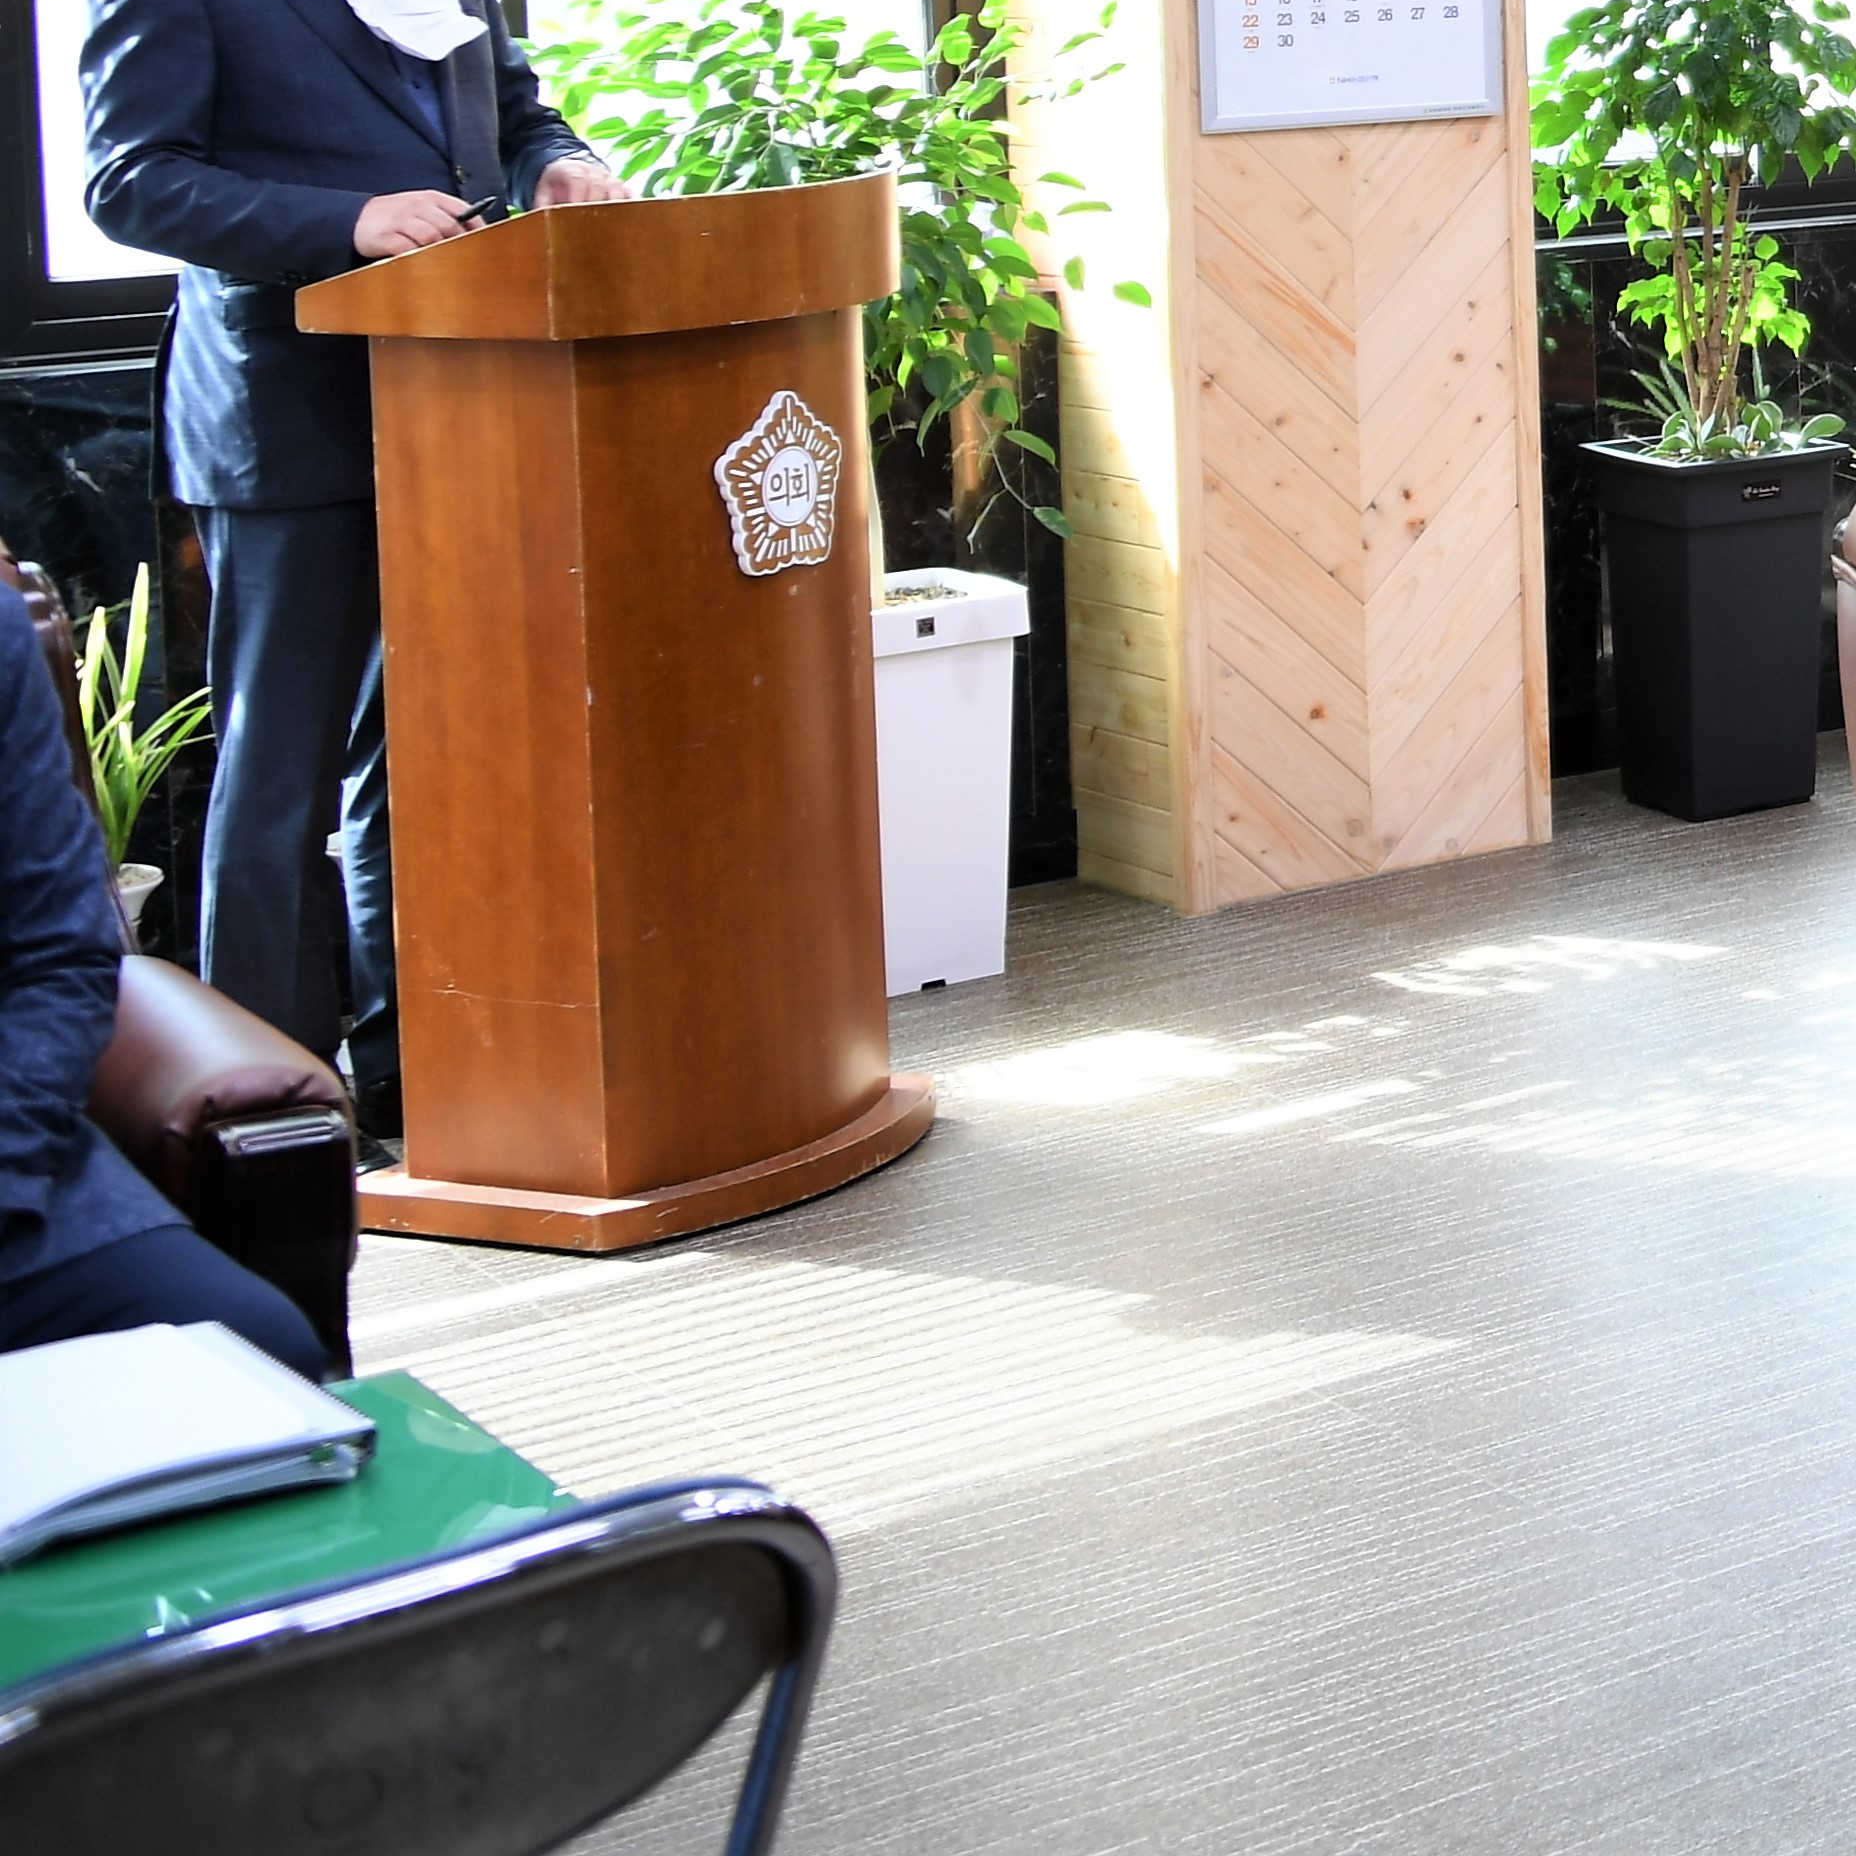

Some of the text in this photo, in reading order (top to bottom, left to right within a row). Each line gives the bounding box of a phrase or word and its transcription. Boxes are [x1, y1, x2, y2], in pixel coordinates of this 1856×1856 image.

[1242, 5, 1459, 28] 22 23 24 25 26 27 28
[1243, 34, 1294, 50] 29 30
[768, 463, 810, 507] 의회
